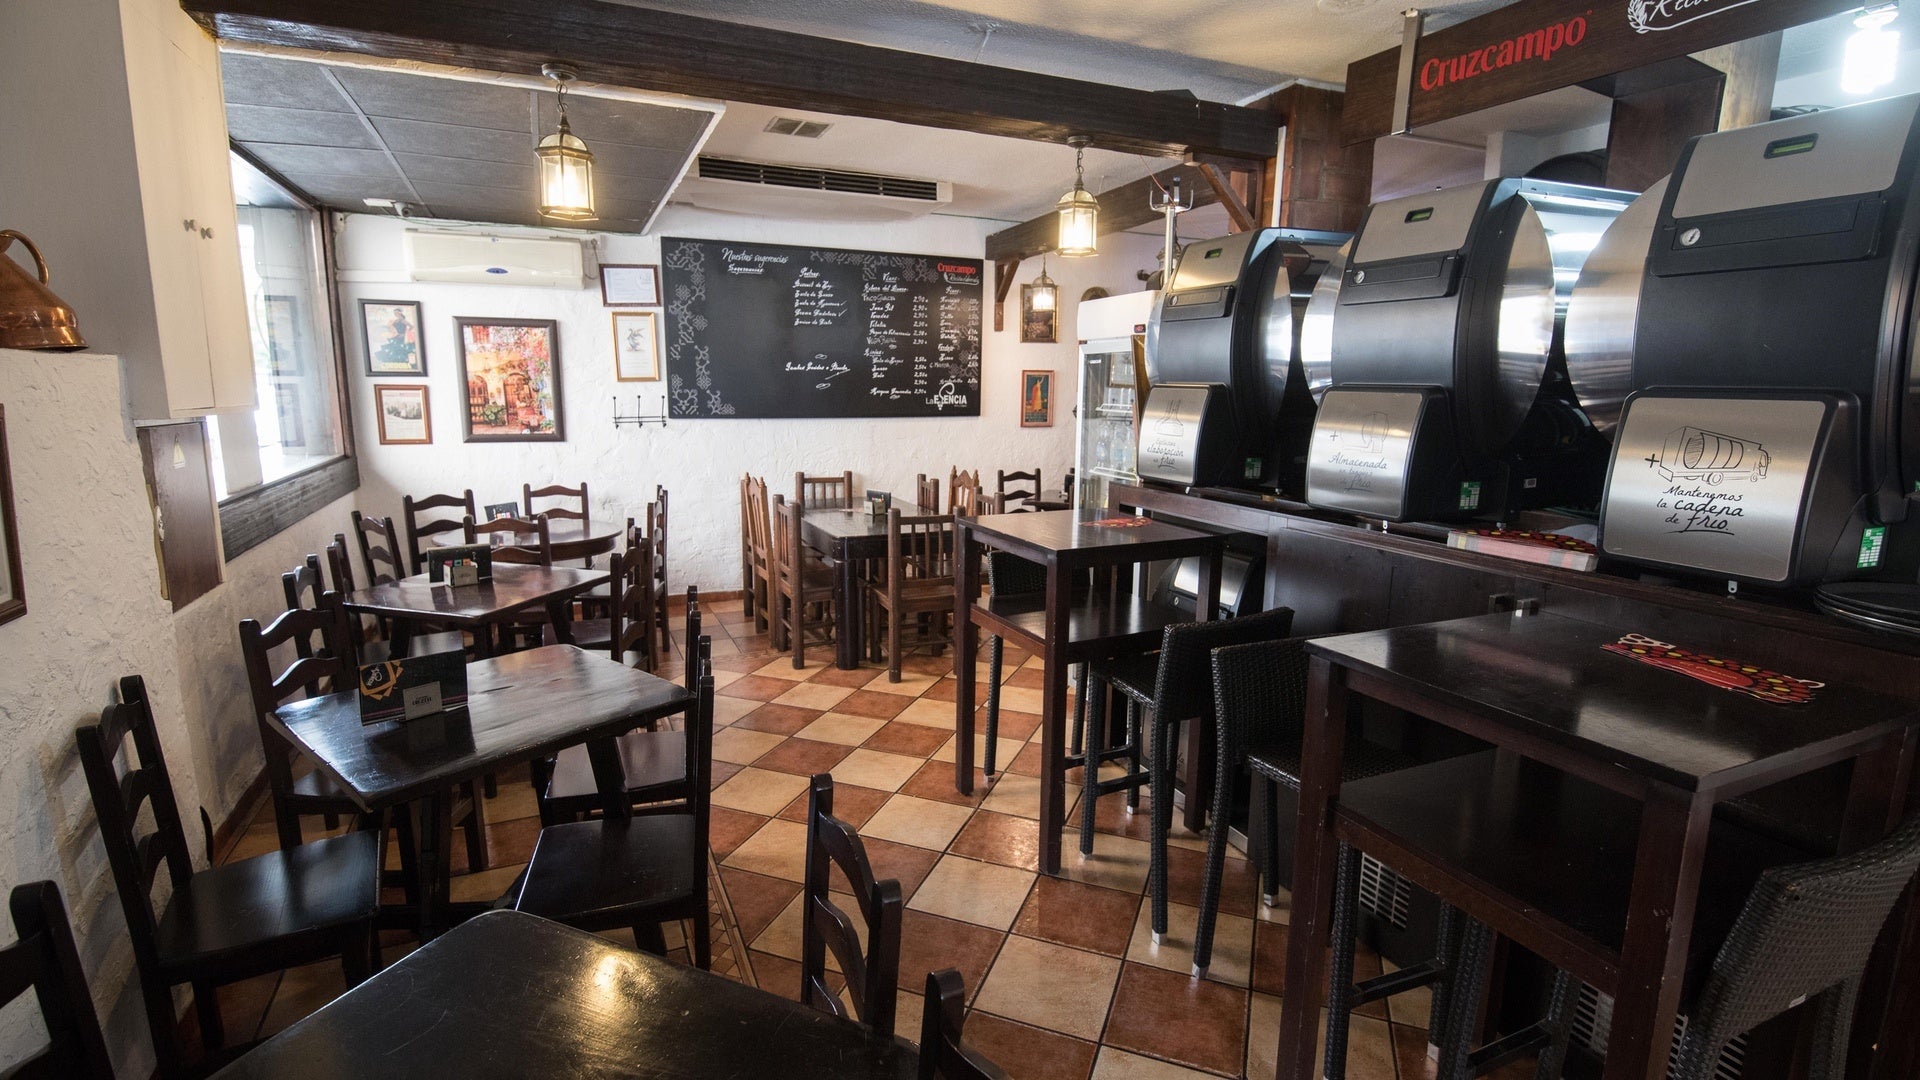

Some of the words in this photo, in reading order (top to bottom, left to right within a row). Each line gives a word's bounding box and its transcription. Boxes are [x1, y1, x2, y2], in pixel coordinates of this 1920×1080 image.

[1420, 17, 1588, 91] Cruzcampo
[937, 262, 976, 276] Cruzcampo
[1328, 452, 1388, 470] Almacenada
[1662, 485, 1744, 503] Mantenemos
[1656, 498, 1668, 509] la
[1674, 497, 1745, 518] cadena
[1665, 513, 1680, 524] de
